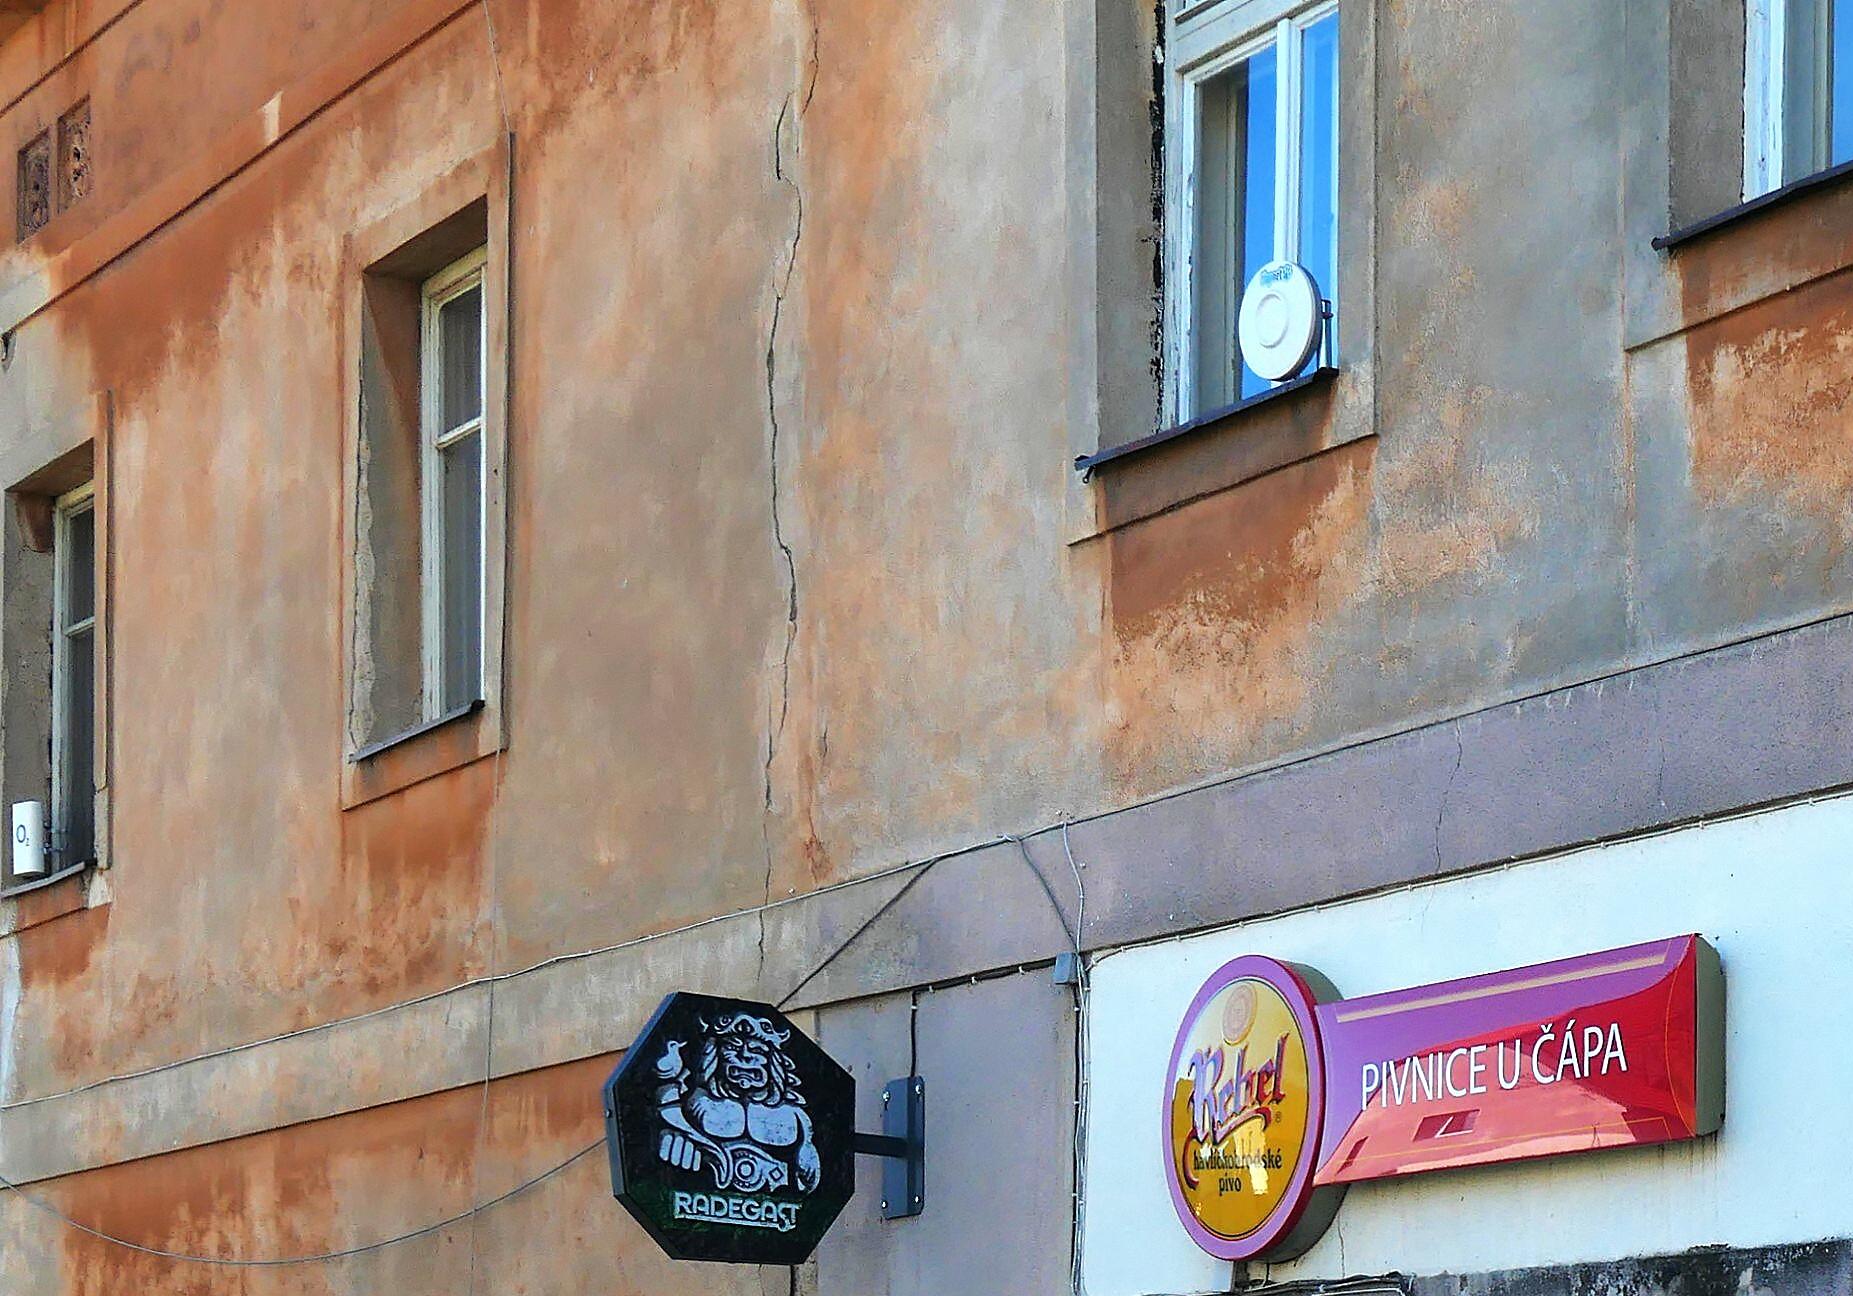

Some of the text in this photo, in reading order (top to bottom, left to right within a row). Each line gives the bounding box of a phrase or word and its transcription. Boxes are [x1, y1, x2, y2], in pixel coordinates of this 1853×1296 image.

[1362, 1019, 1628, 1111] PIVNICE U ČÁPA
[1183, 1031, 1290, 1190] Rebel
[674, 1191, 803, 1232] RADEGAST
[1218, 1172, 1242, 1197] pivo
